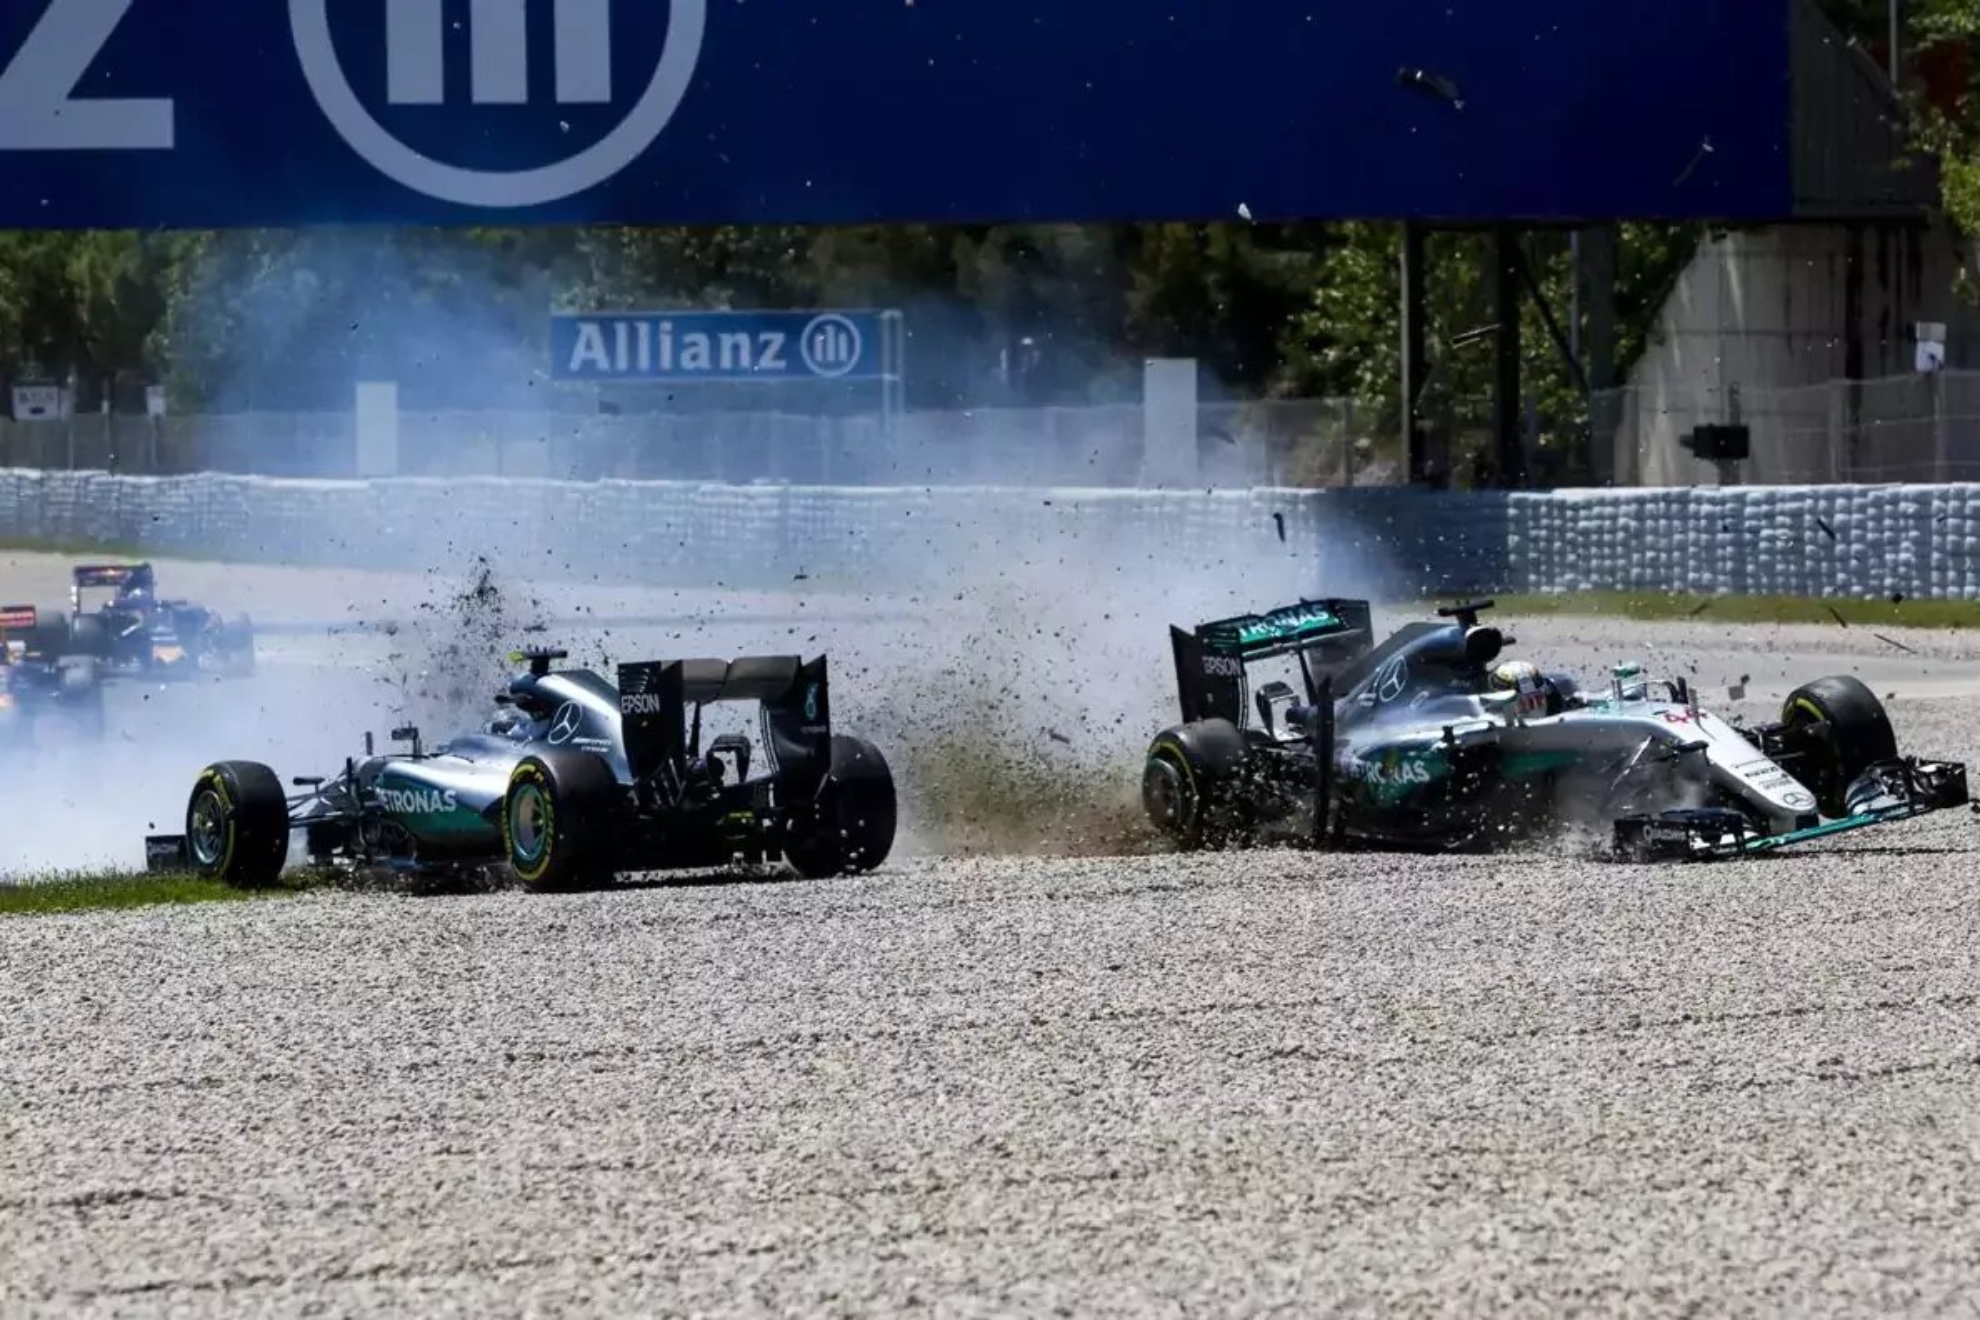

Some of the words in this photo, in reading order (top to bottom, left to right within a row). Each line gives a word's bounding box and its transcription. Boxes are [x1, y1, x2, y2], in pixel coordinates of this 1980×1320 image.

[569, 321, 787, 371] Allianz
[1202, 656, 1241, 676] EPSON
[621, 694, 660, 714] EPSON
